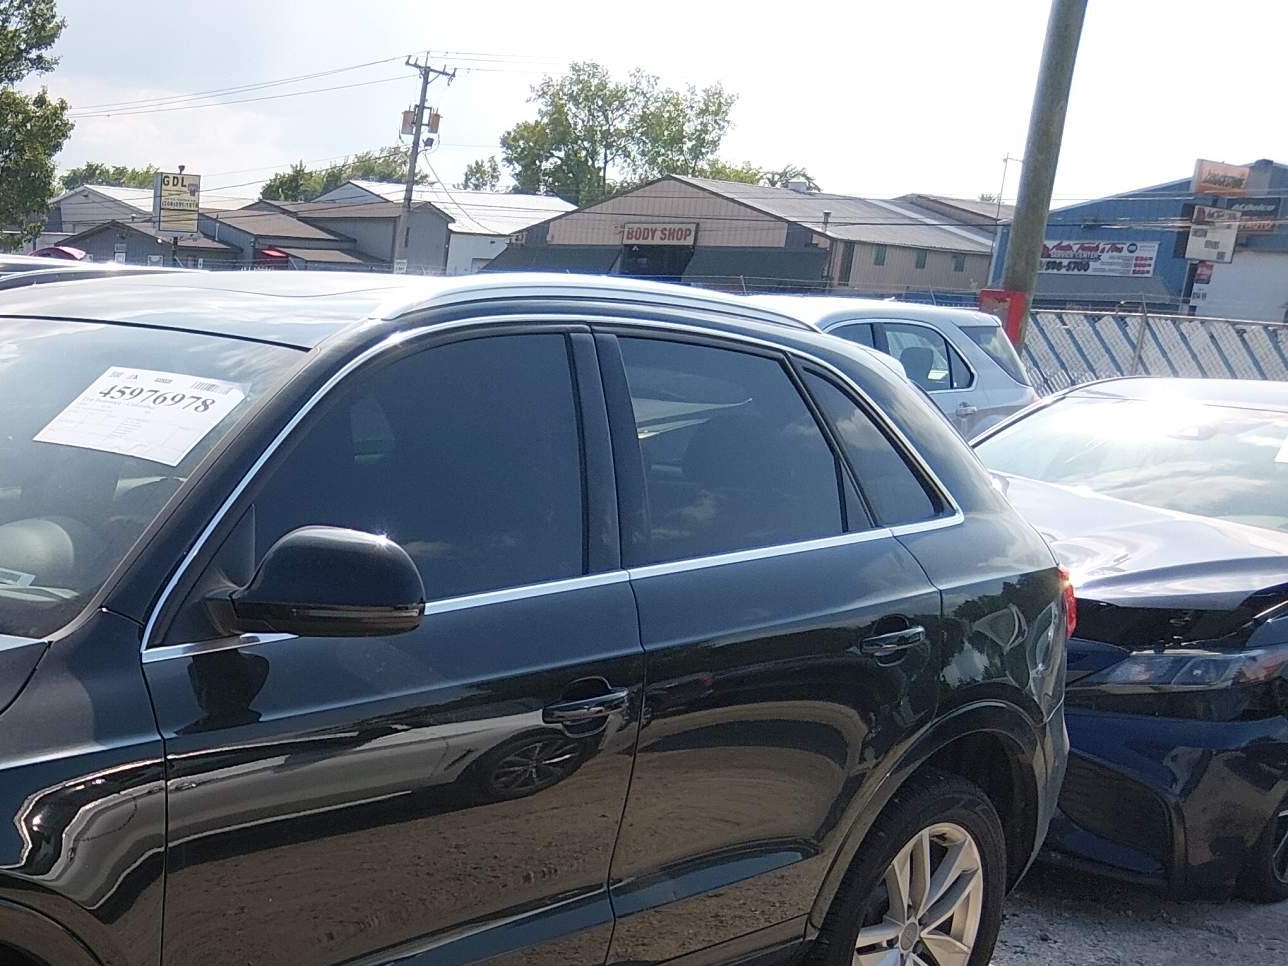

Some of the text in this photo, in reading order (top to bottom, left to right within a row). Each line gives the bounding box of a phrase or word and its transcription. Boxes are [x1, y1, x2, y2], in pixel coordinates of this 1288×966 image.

[162, 175, 187, 187] GDL
[626, 226, 692, 241] BODY SHOP
[98, 384, 216, 413] 45976978
